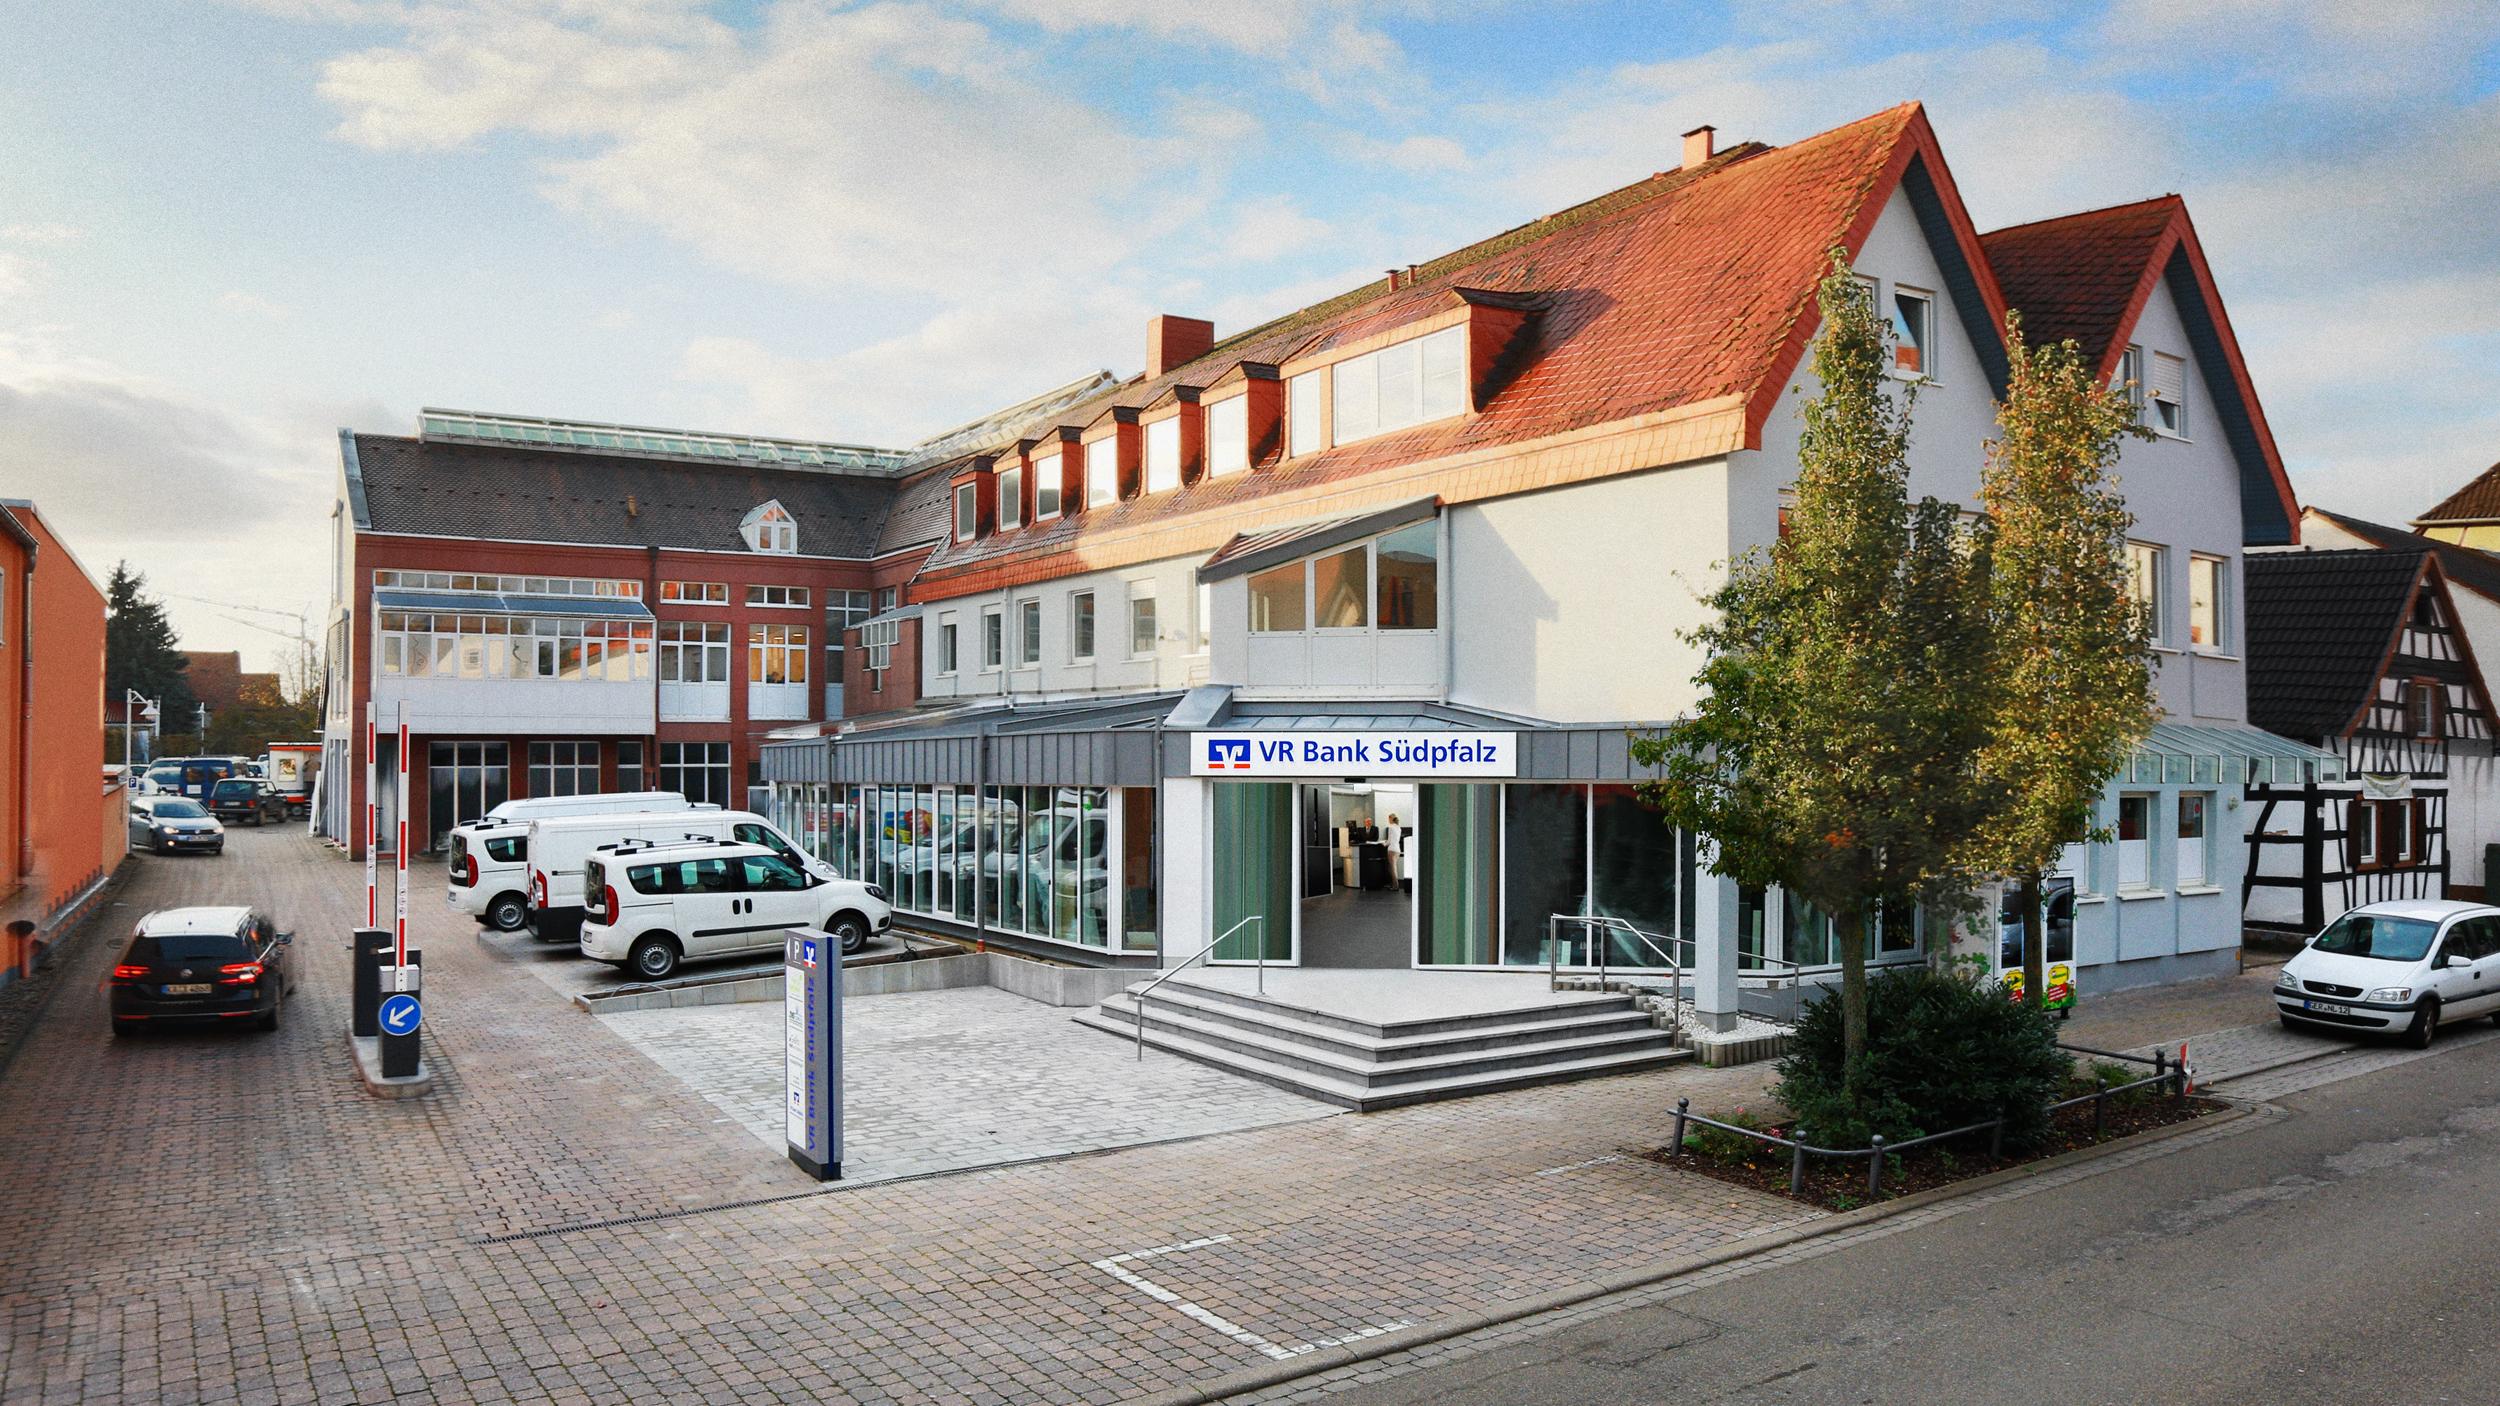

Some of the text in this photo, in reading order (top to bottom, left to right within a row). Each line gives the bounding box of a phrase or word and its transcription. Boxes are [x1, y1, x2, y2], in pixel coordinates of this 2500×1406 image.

[1258, 739, 1496, 768] VR Bank Südpfalz
[794, 941, 800, 960] P
[808, 1071, 816, 1119] Bank
[808, 1125, 816, 1151] VR
